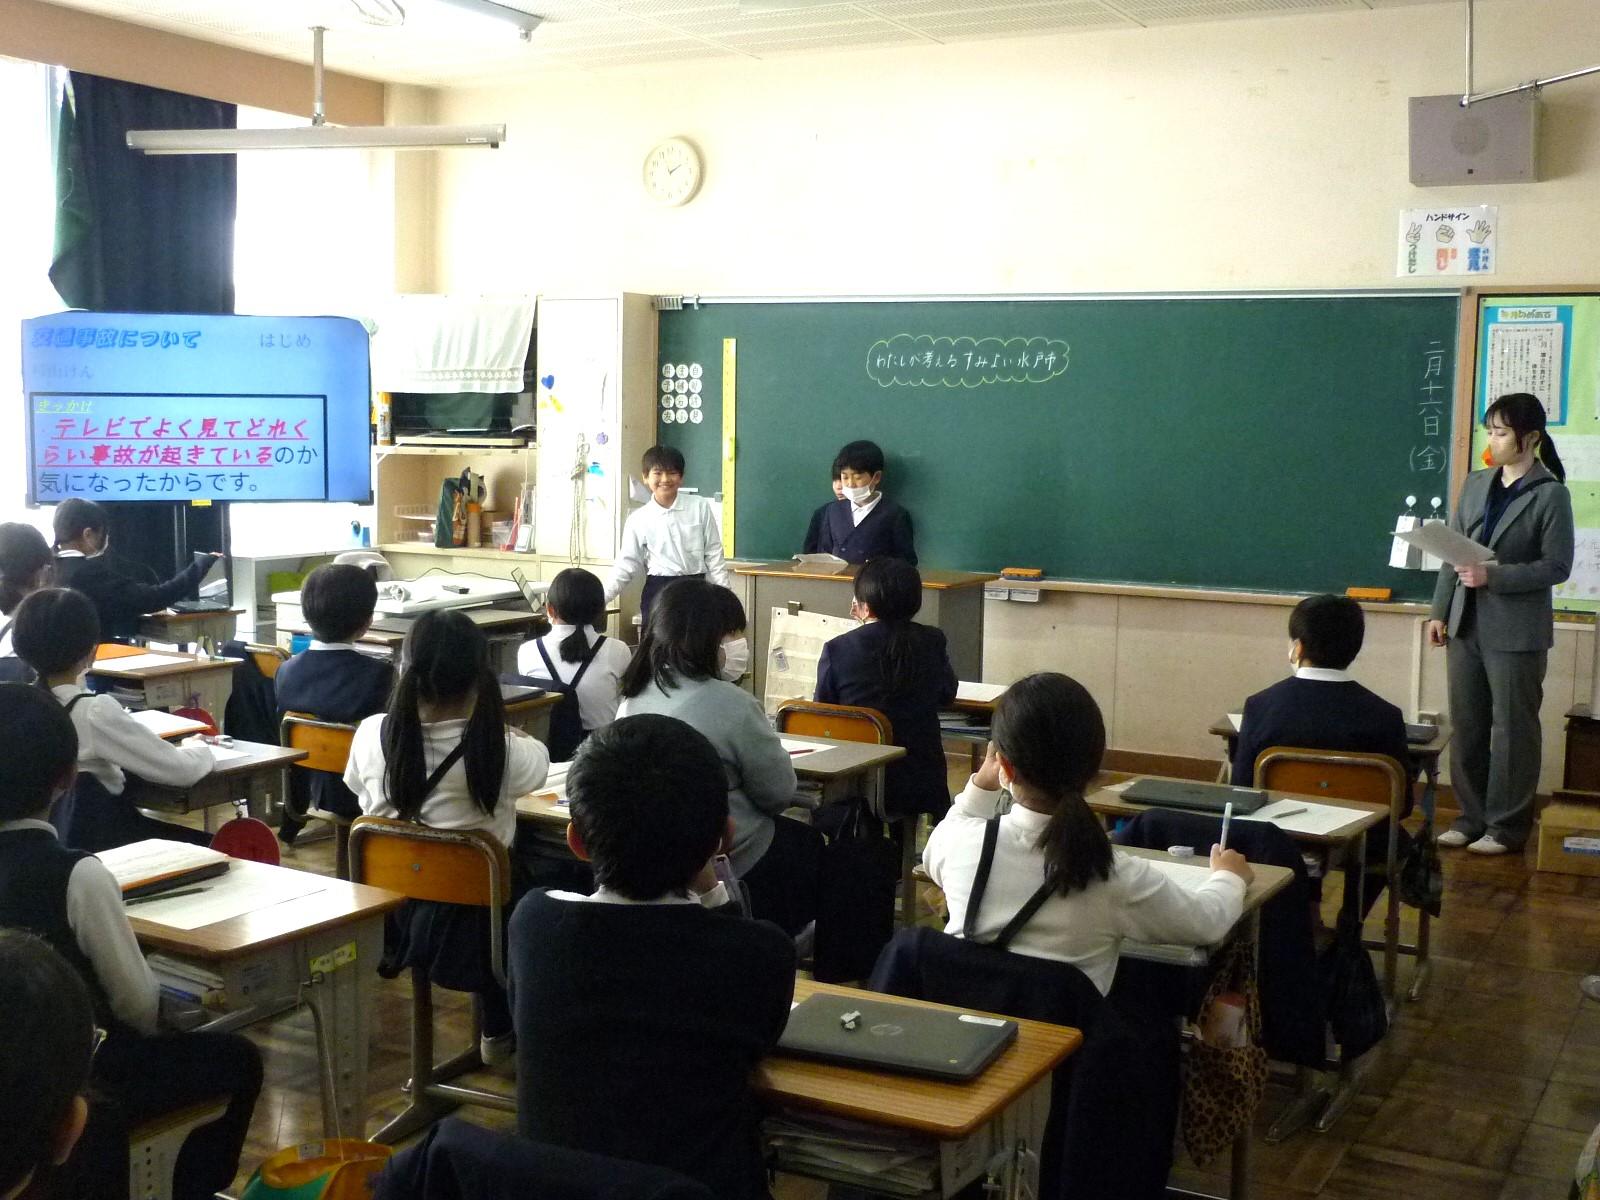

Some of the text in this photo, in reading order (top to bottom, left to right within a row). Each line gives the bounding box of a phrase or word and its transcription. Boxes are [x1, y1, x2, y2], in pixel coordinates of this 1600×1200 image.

[1426, 212, 1470, 222] ハンドサイン
[32, 327, 201, 350] 交通事故について
[260, 332, 312, 349] はじめ
[55, 416, 310, 438] テレビでよく見てどれく
[43, 444, 319, 466] らい事故が起きているのか
[39, 472, 260, 493] 気になったからです。
